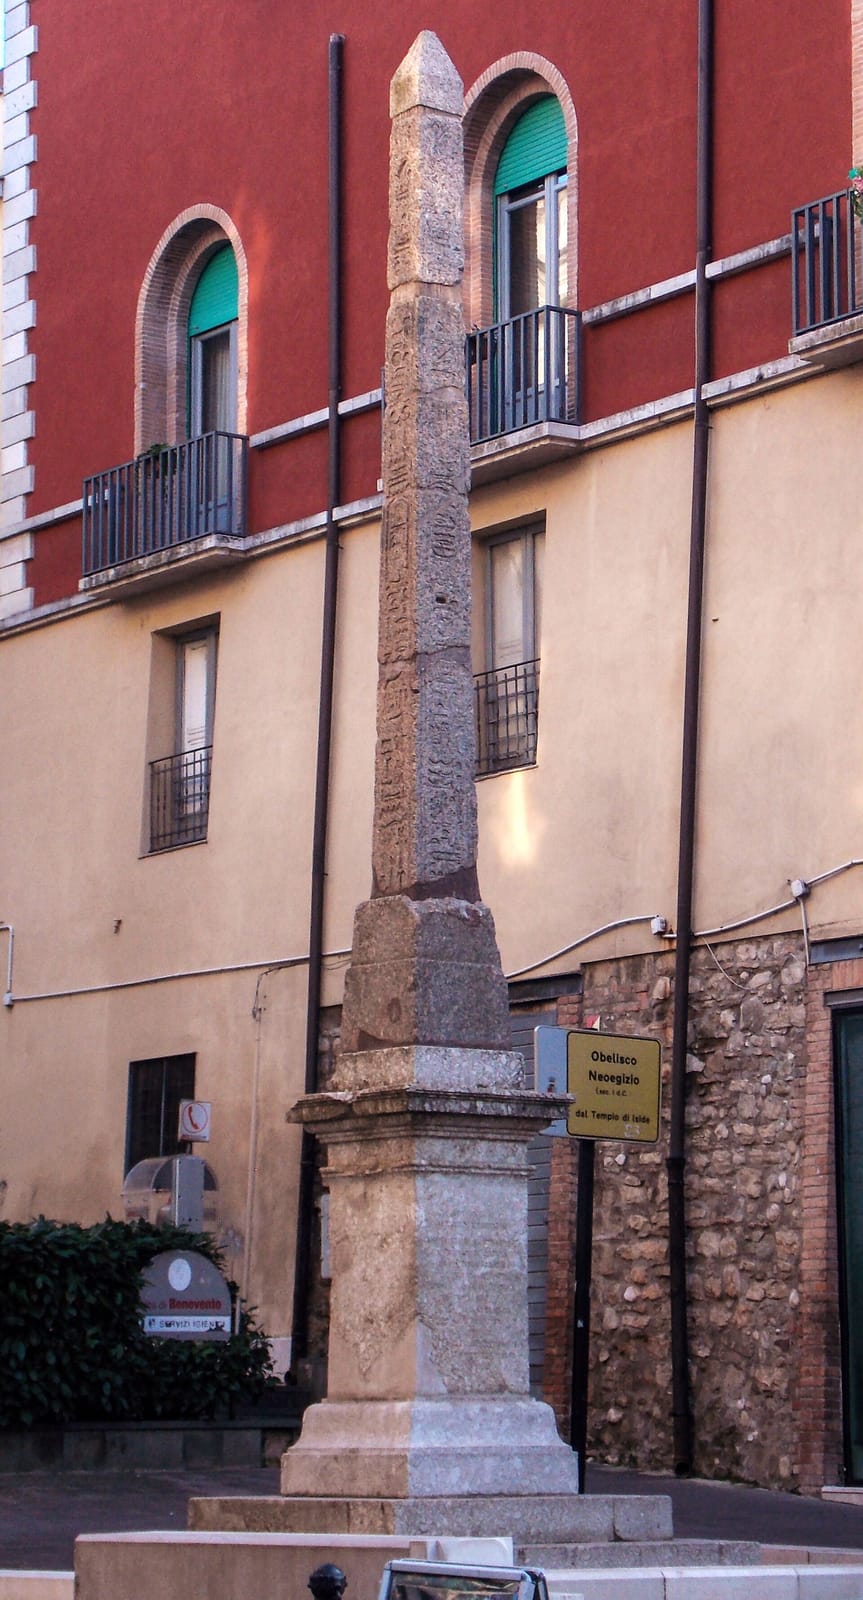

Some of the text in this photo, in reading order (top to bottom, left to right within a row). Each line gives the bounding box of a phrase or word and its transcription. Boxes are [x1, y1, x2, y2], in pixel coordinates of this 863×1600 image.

[591, 1051, 637, 1065] Obelisco
[588, 1070, 640, 1085] Neoegizio
[575, 1109, 651, 1124] dal Tempio di Iside
[168, 1298, 222, 1311] Benevento
